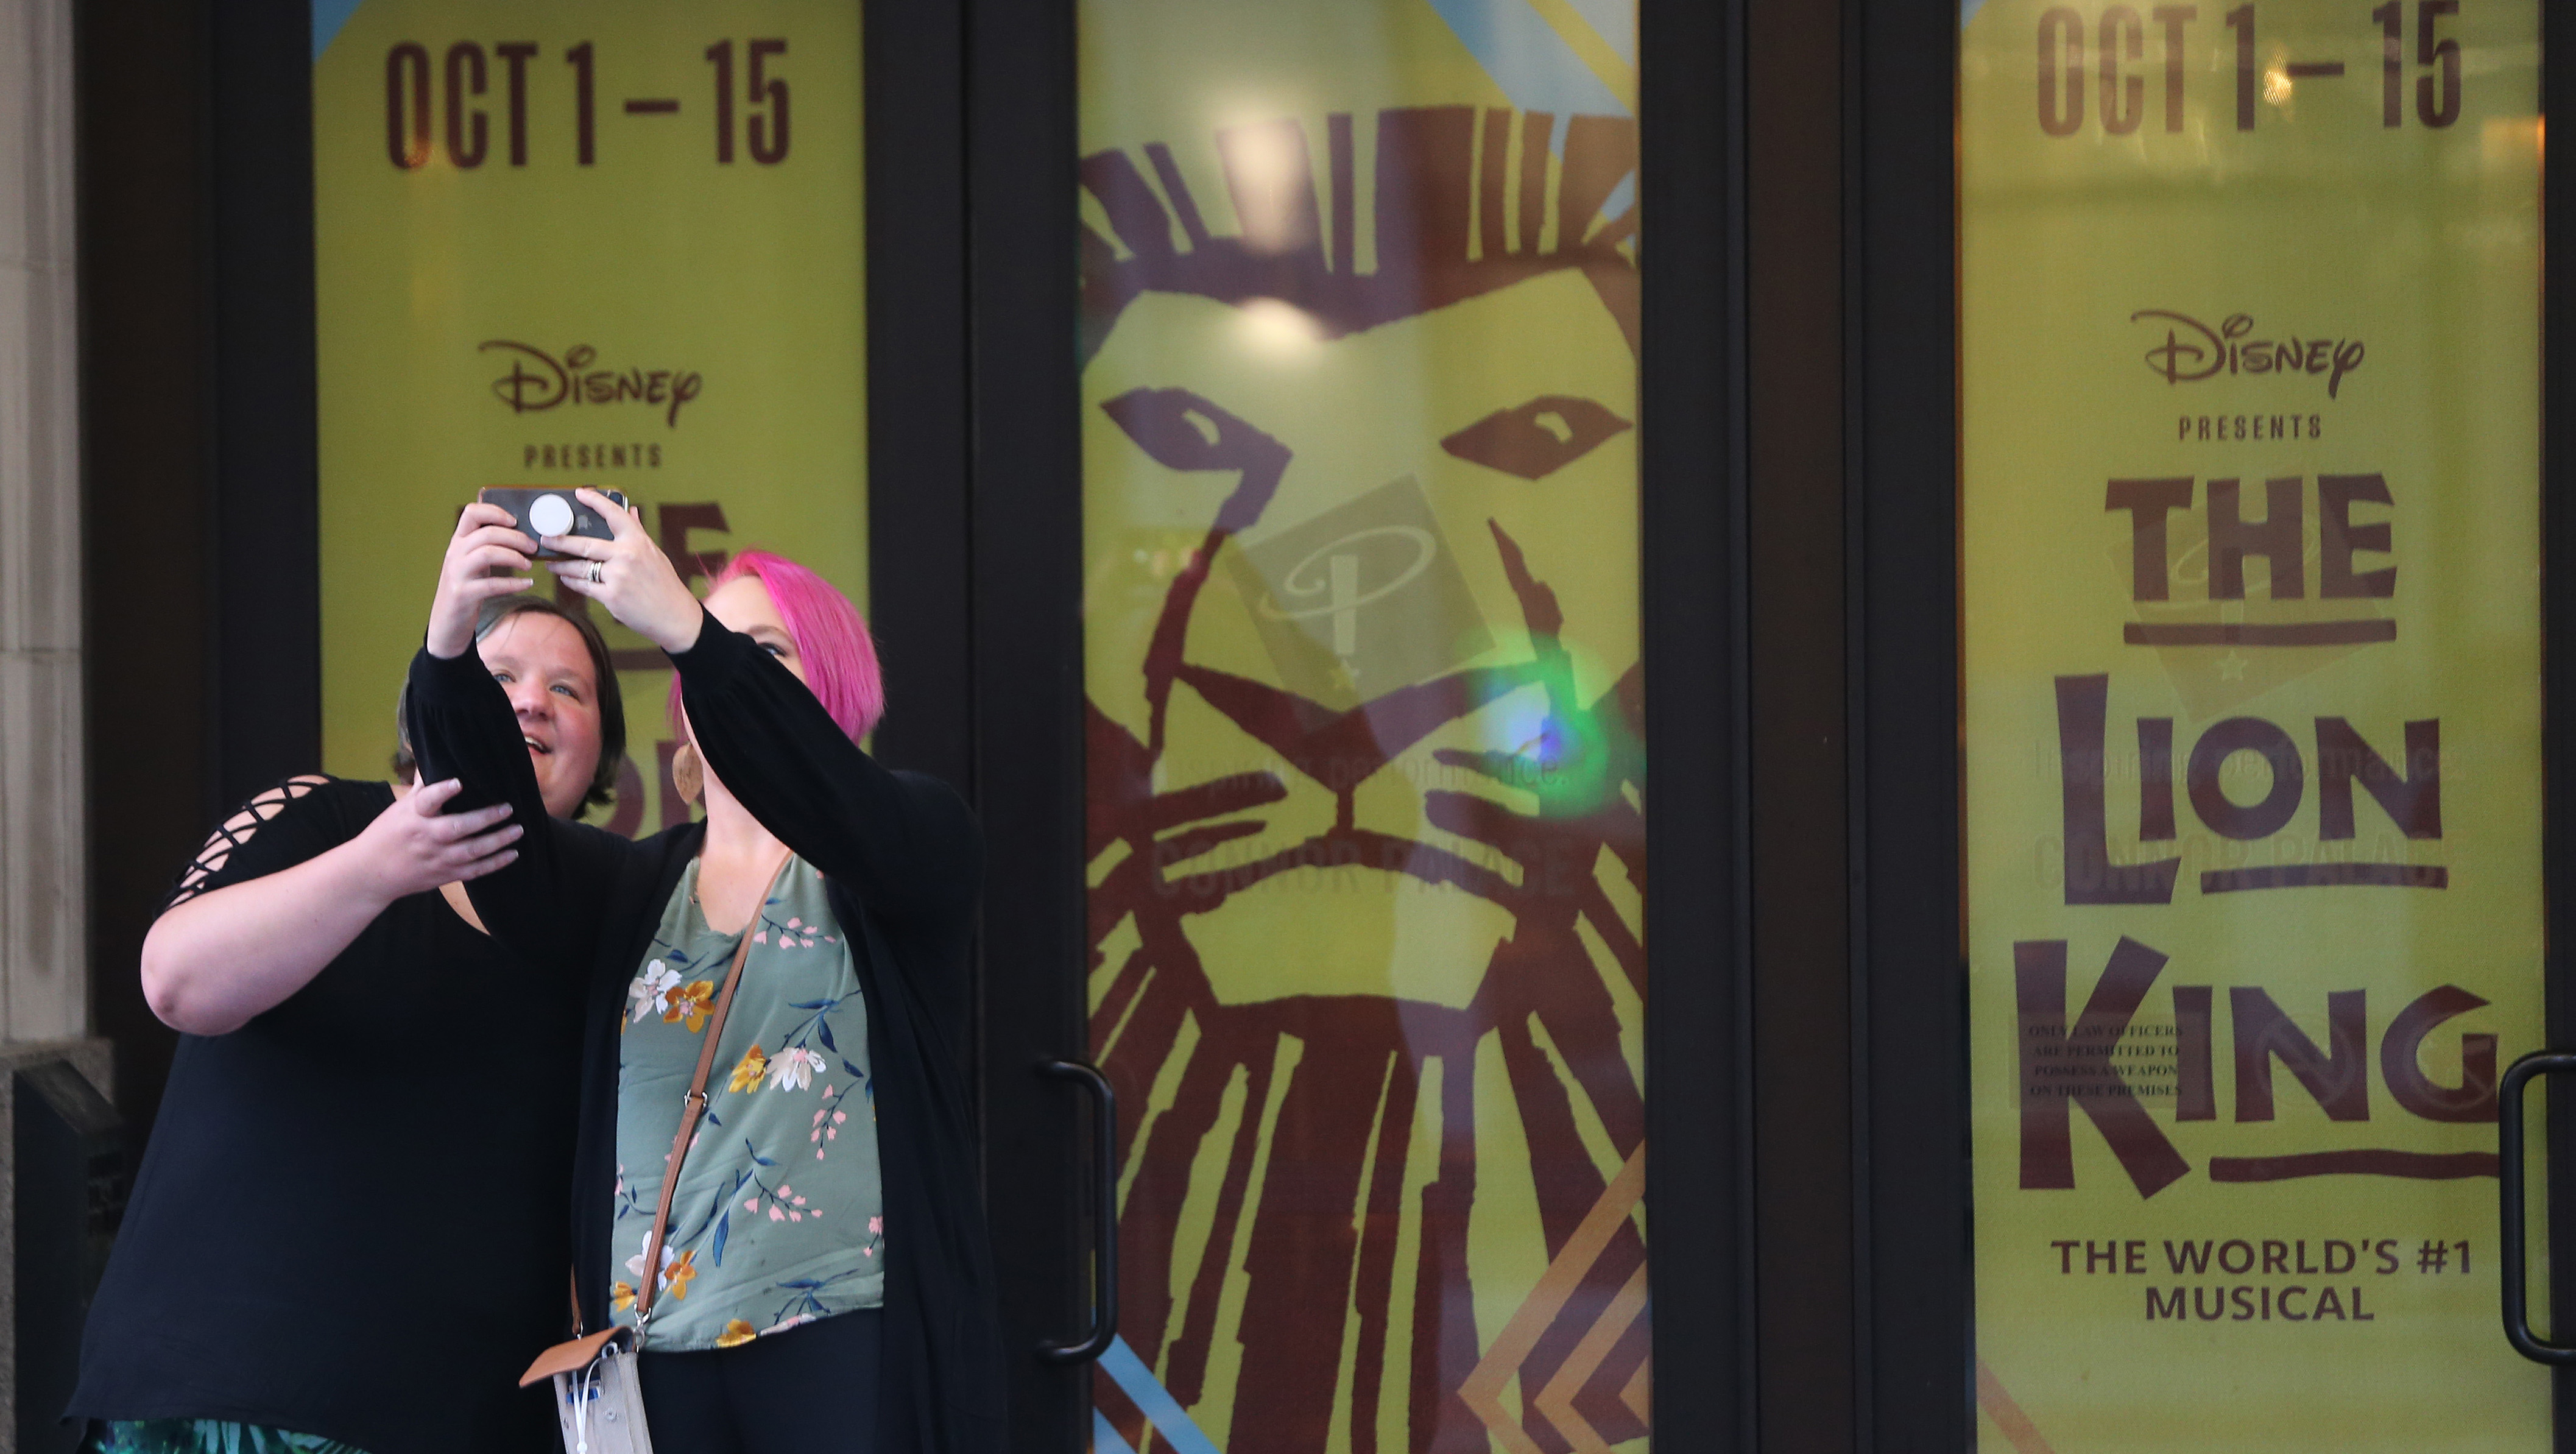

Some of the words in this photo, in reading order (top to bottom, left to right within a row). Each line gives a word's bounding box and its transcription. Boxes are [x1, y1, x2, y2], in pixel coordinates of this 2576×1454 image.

[386, 41, 538, 170] OCT
[566, 41, 595, 166] 1
[705, 39, 790, 165] 15
[2037, 7, 2197, 137] OCT
[2226, 3, 2256, 132] 1
[2372, 0, 2461, 129] 15
[524, 443, 662, 470] PRESENTS
[2179, 414, 2321, 440] PRESENTS
[2105, 473, 2398, 601] THE
[2054, 673, 2443, 905] LION
[2014, 935, 2499, 1200] KING
[2050, 1240, 2147, 1274] THE
[2164, 1239, 2399, 1275] WORLD'S
[2416, 1240, 2471, 1274] #1
[2146, 1285, 2374, 1321] MUSICAL
